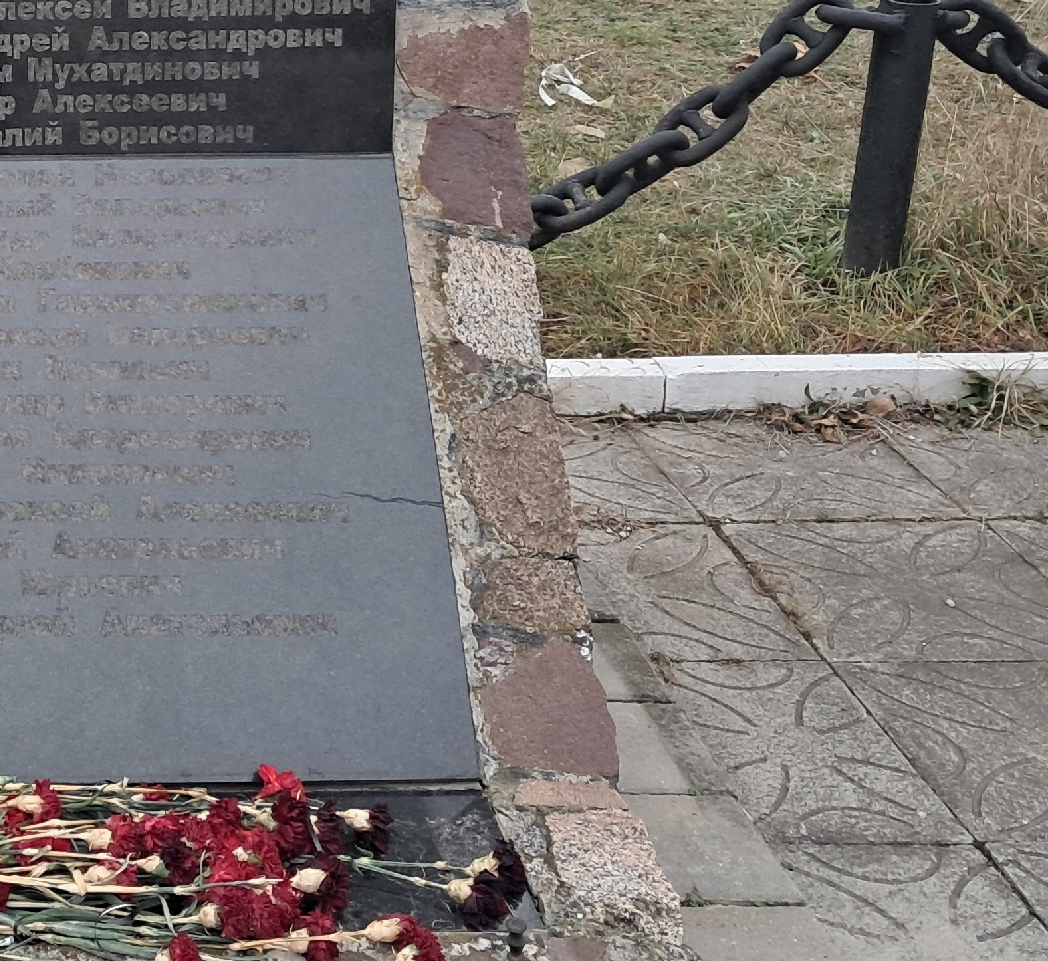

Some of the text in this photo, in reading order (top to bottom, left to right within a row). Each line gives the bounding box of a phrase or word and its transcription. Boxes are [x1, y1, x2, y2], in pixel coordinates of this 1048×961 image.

[87, 24, 344, 55] Александрович
[27, 56, 260, 89] Мухатдинович
[32, 88, 227, 114] Алексеевич
[78, 119, 254, 150] Борисович
